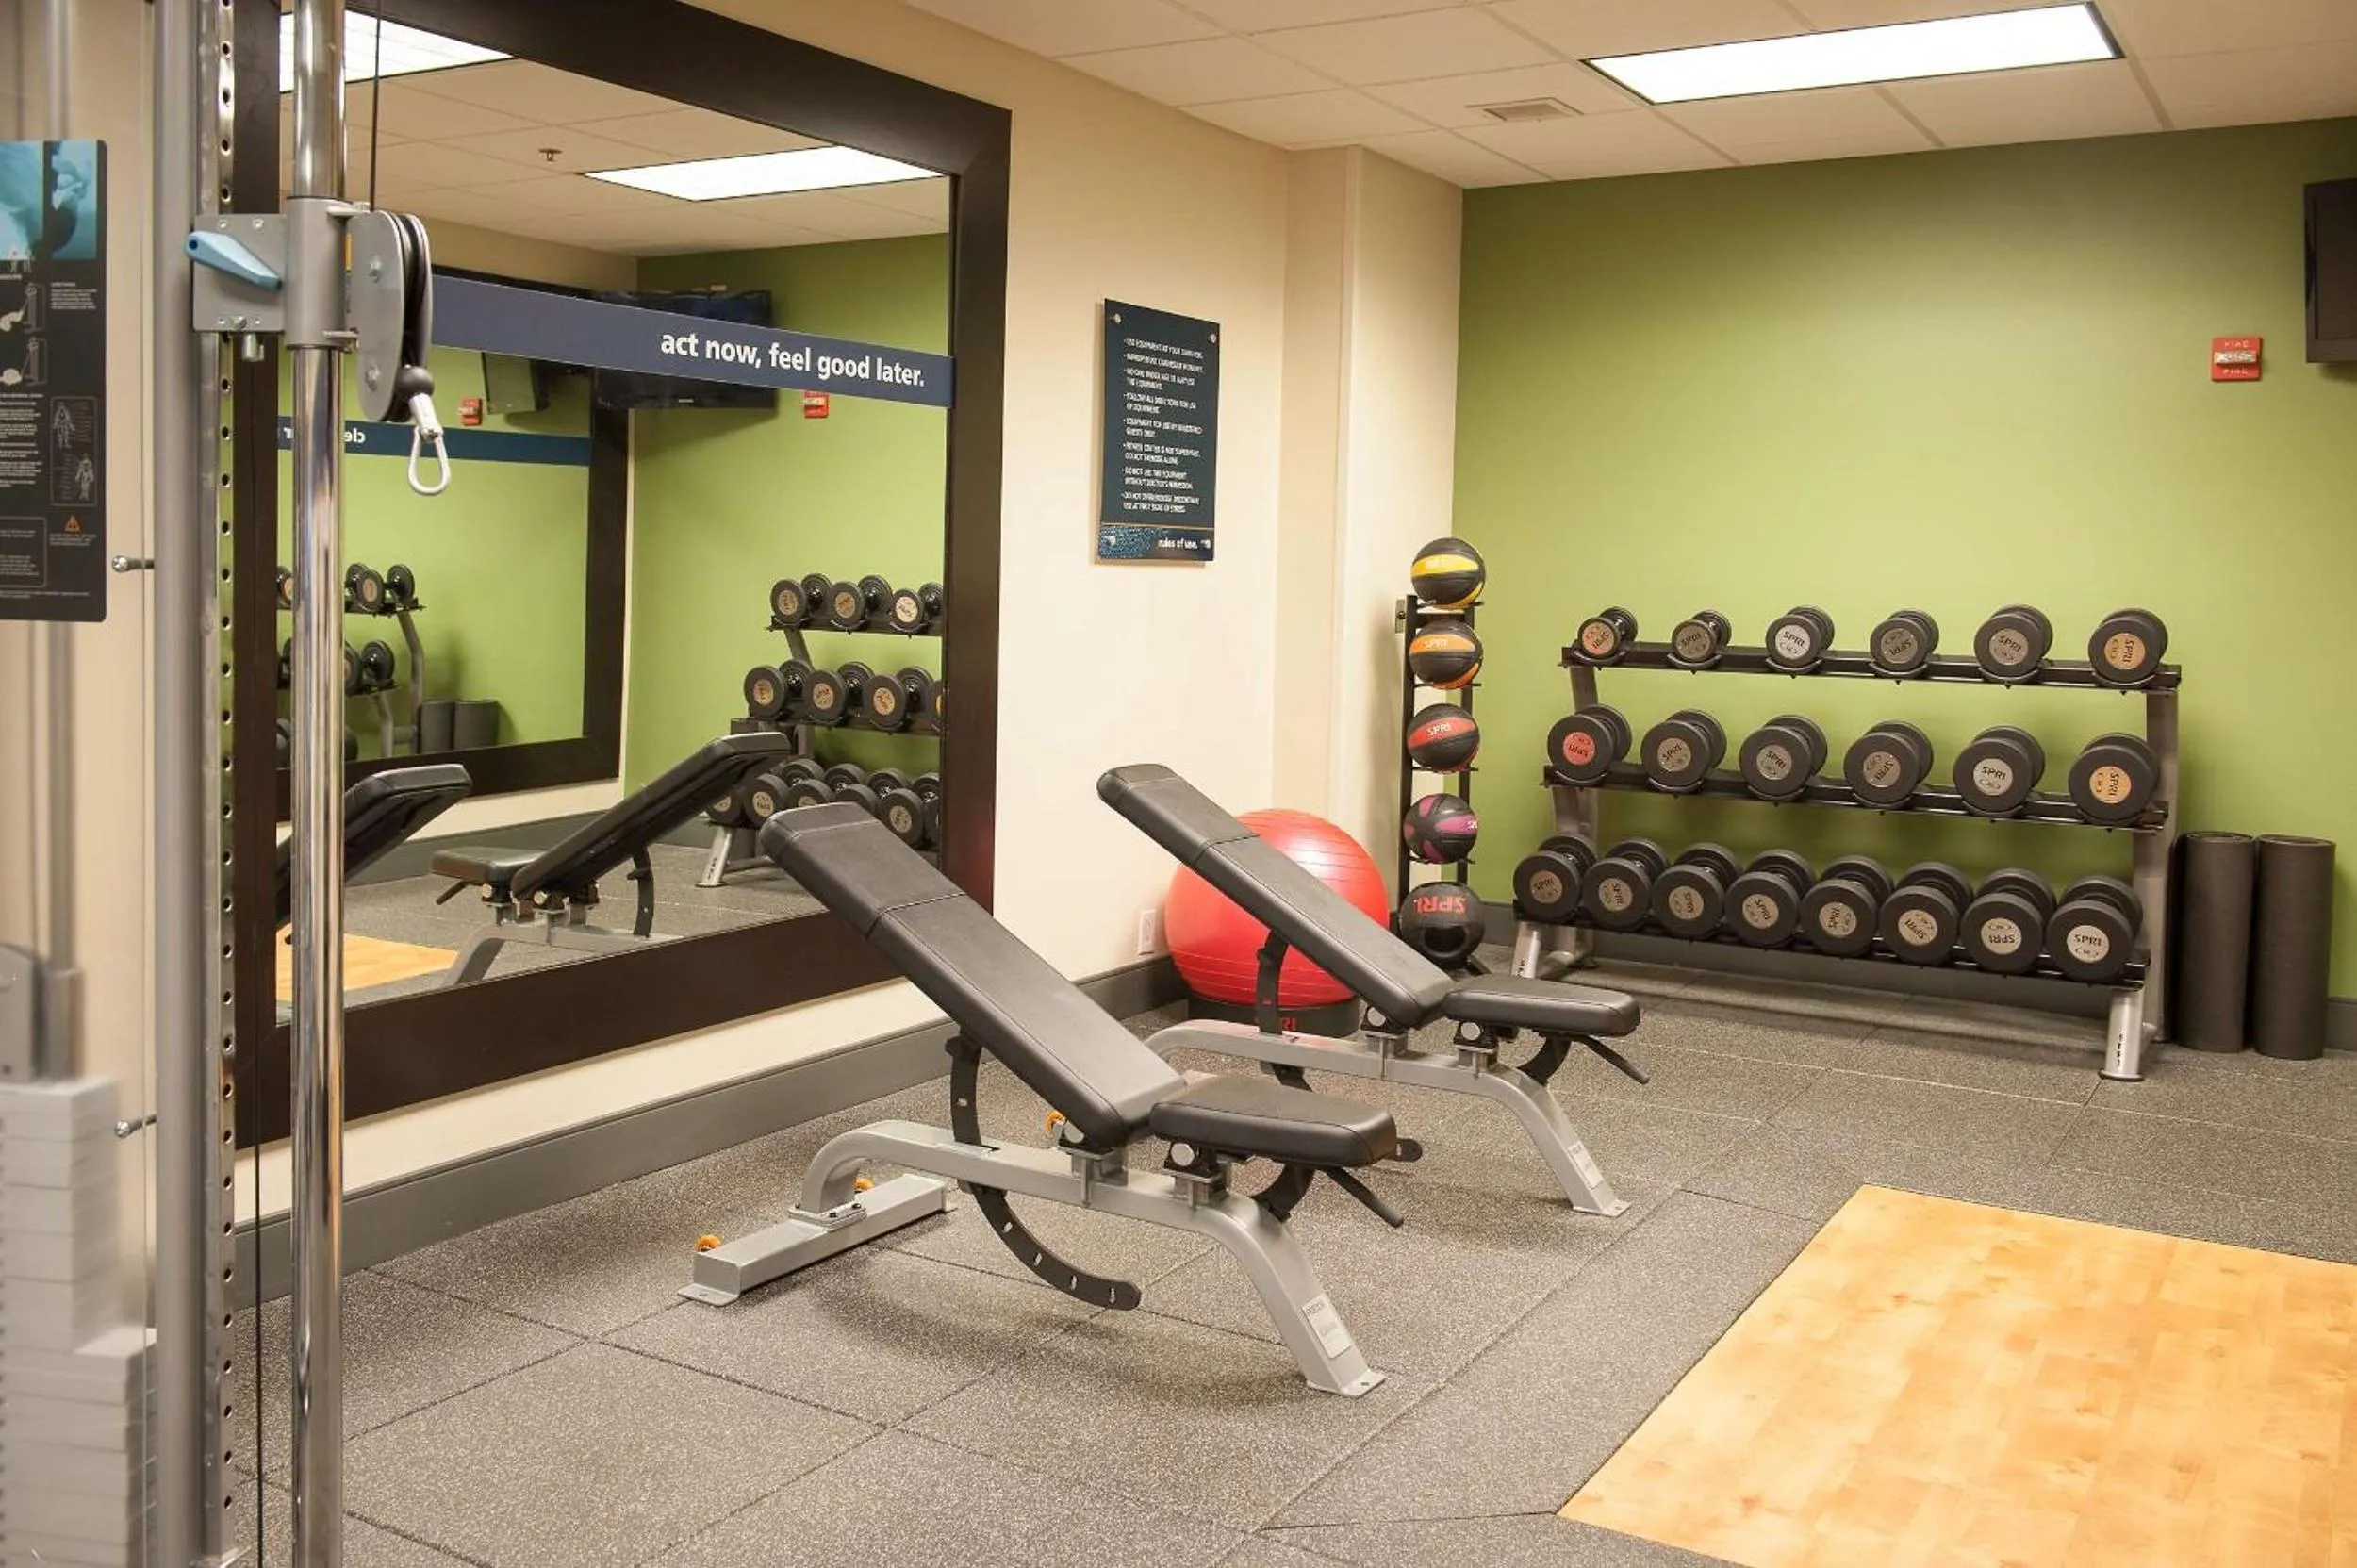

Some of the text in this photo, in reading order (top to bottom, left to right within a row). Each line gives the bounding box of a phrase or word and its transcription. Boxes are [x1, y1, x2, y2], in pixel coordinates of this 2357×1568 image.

[661, 333, 925, 386] act now, feel good later.
